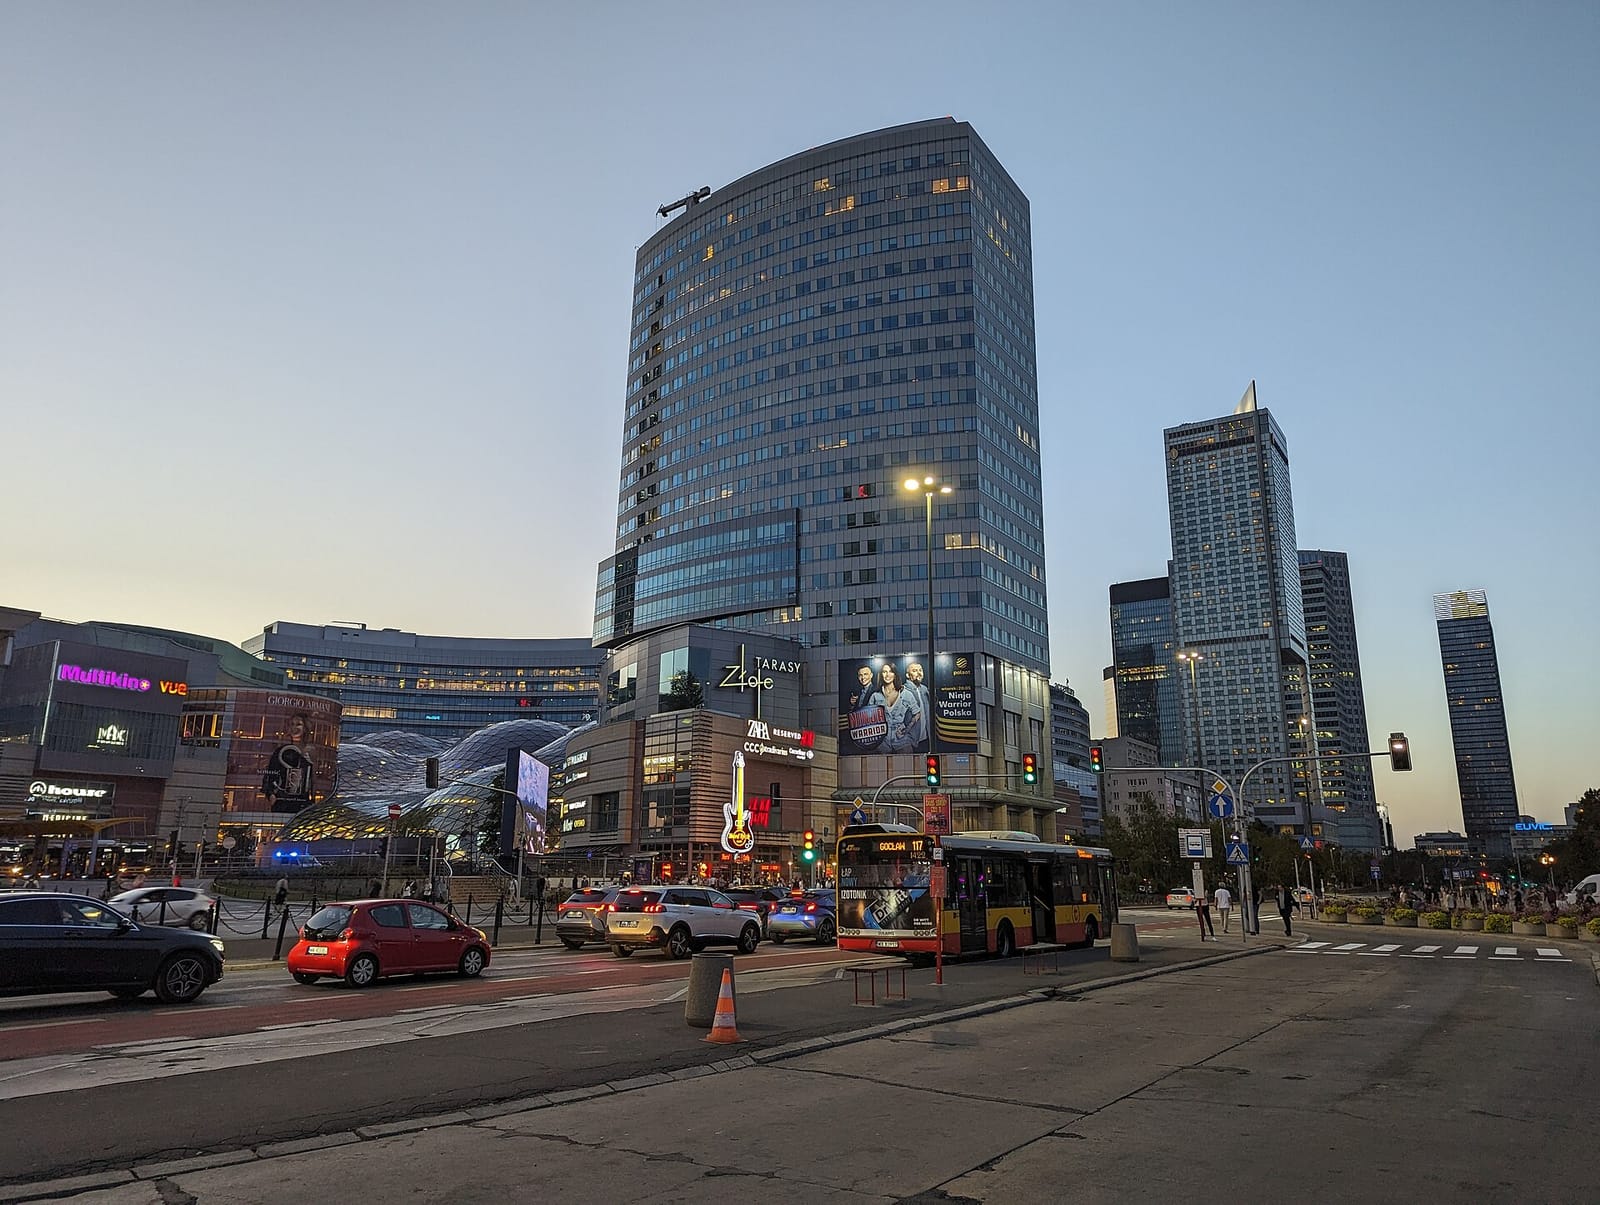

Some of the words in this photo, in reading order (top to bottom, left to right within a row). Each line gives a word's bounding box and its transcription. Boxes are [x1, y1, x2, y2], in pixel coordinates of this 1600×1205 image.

[58, 664, 151, 692] Multikino
[720, 643, 774, 720] Złote
[755, 656, 801, 673] TARASY
[267, 695, 305, 709] GIORGIO
[948, 692, 972, 701] Ninja
[938, 700, 972, 708] Warrior
[943, 709, 972, 717] Polska
[747, 719, 771, 741] ZARA
[773, 728, 802, 741] RESERVED
[851, 724, 887, 739] WARRIOR
[744, 741, 760, 753] CCC
[879, 842, 906, 851] GOCŁAW
[911, 841, 923, 851] 117
[841, 890, 867, 899] IZOTONIK
